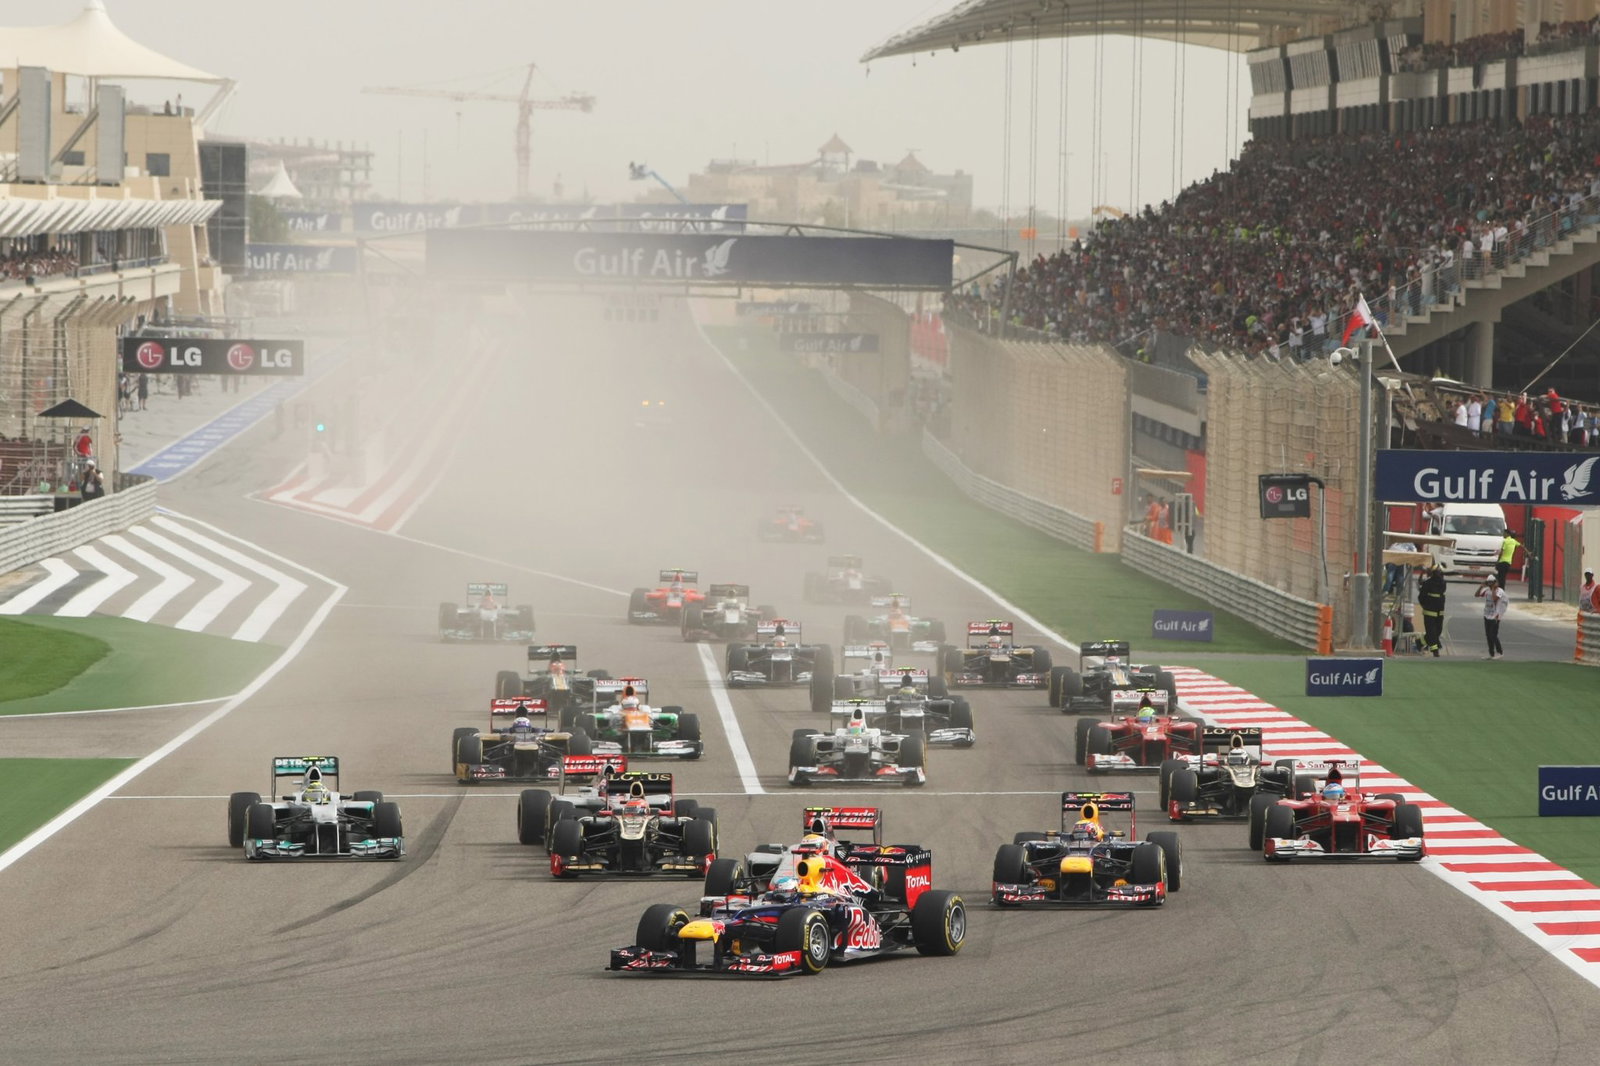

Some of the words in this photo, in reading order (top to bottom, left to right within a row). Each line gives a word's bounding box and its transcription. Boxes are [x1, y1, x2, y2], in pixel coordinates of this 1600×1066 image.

[295, 217, 313, 231] Air
[371, 210, 412, 230] Gulf
[414, 211, 441, 231] Air
[283, 252, 312, 270] Air
[573, 248, 643, 275] Gulf
[650, 249, 697, 277] Air
[170, 346, 202, 366] LG
[260, 348, 292, 368] LG
[1413, 468, 1494, 499] Gulf
[1501, 469, 1555, 500] Air
[1287, 488, 1307, 501] LG
[1154, 620, 1178, 631] Gulf
[1181, 621, 1196, 632] Air
[1310, 672, 1339, 685] Gulf
[1343, 673, 1363, 685] Air
[1203, 727, 1260, 735] LOUS
[609, 773, 671, 781] LOUS
[1542, 785, 1583, 801] Gulf
[905, 875, 930, 889] TOTAL
[773, 954, 796, 965] TOTAL
